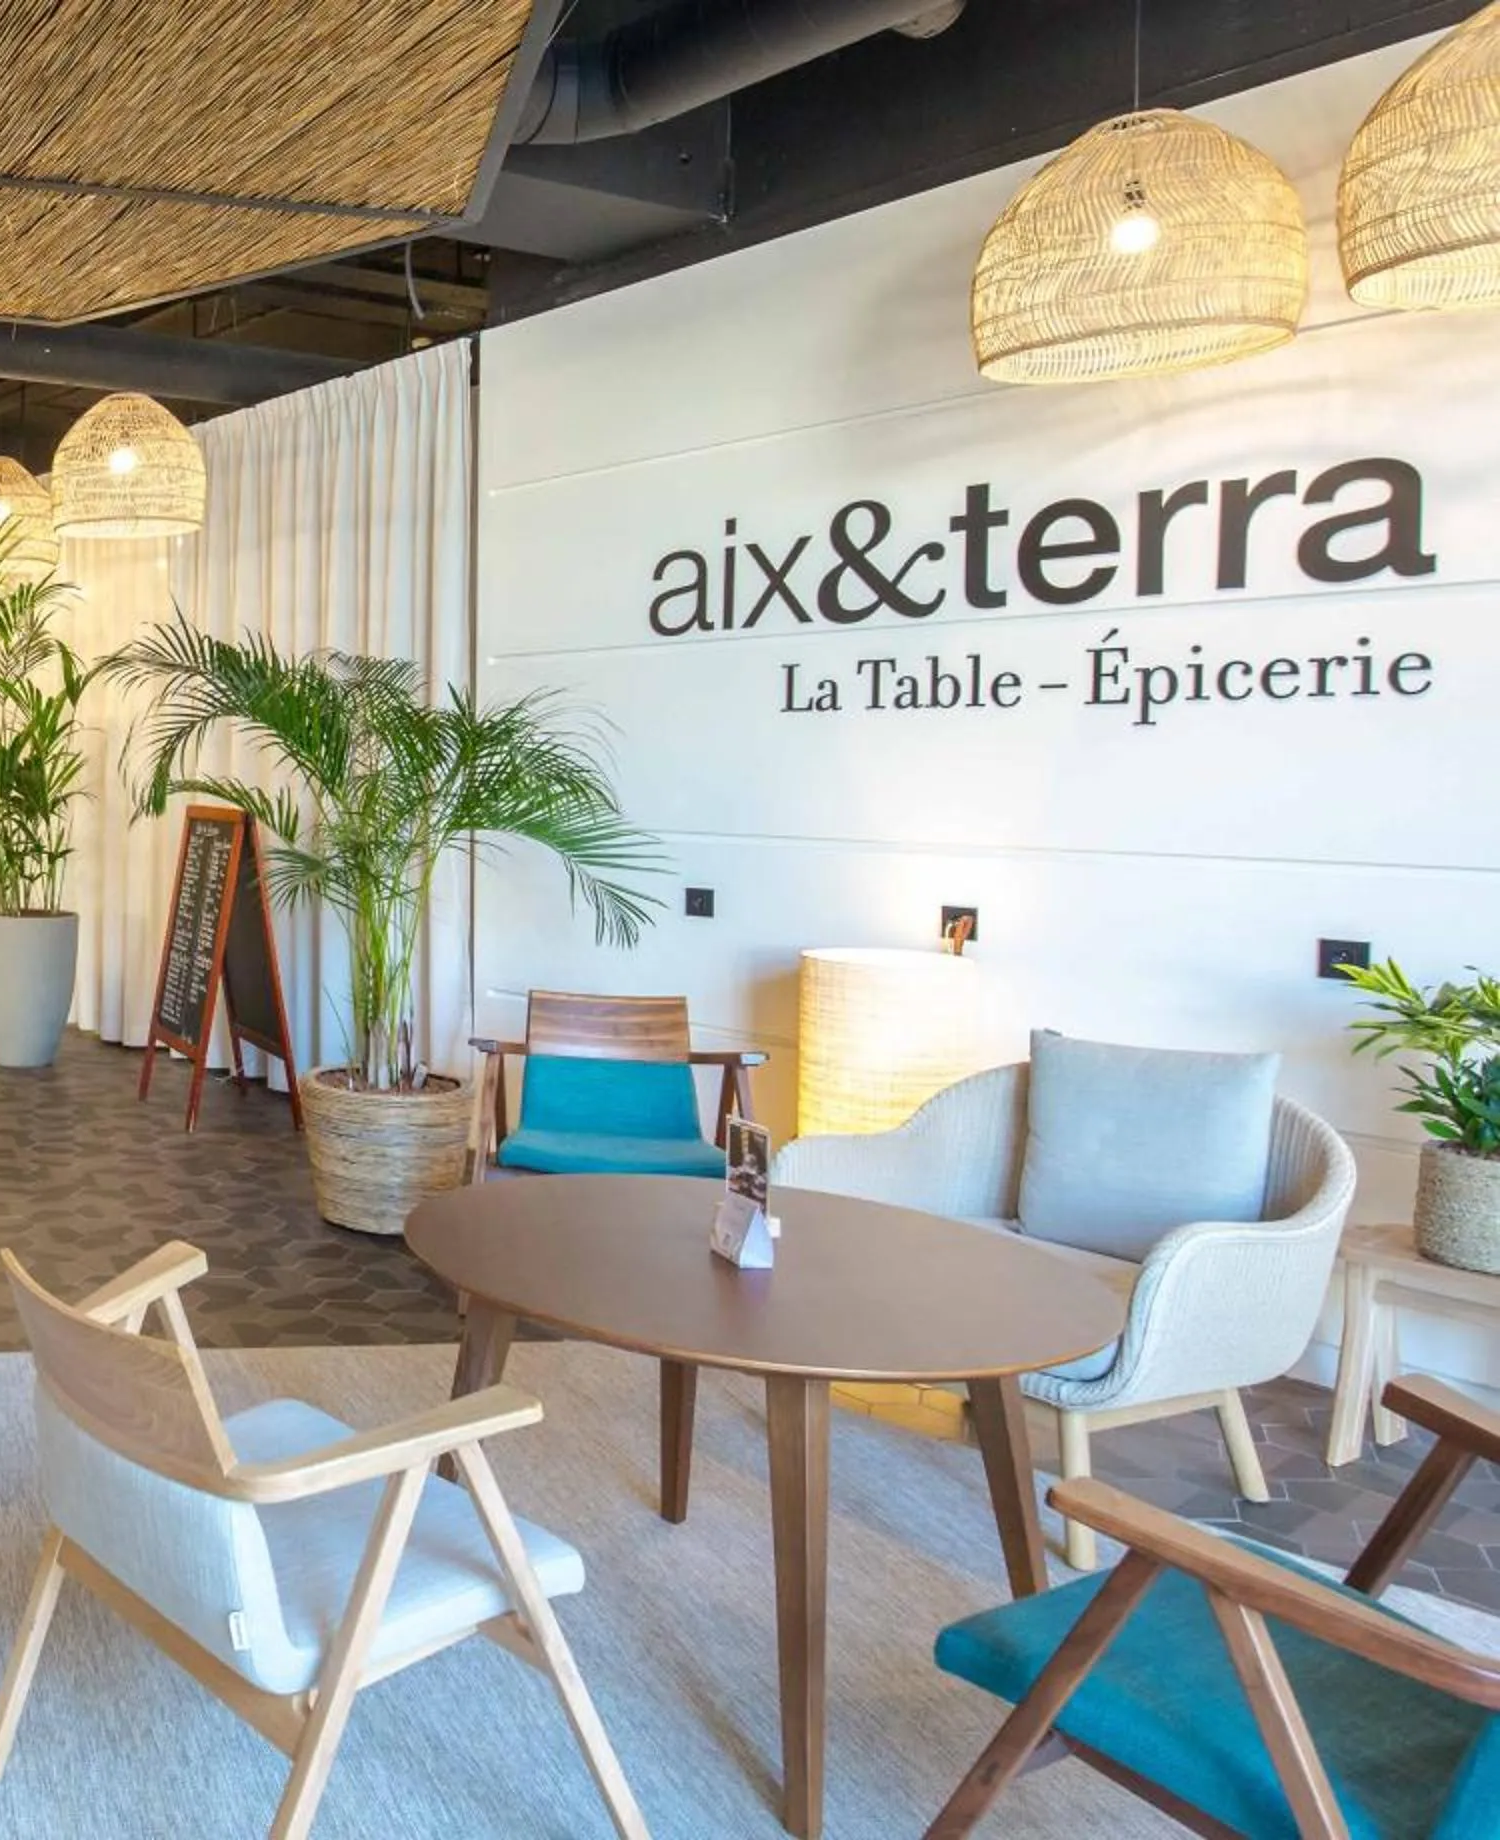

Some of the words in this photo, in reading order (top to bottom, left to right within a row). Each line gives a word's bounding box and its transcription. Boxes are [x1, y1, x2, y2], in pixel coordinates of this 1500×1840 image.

[648, 456, 1437, 637] aix&terra
[780, 663, 842, 713] La
[856, 654, 1022, 709] Table
[1083, 628, 1433, 727] Épicerie
